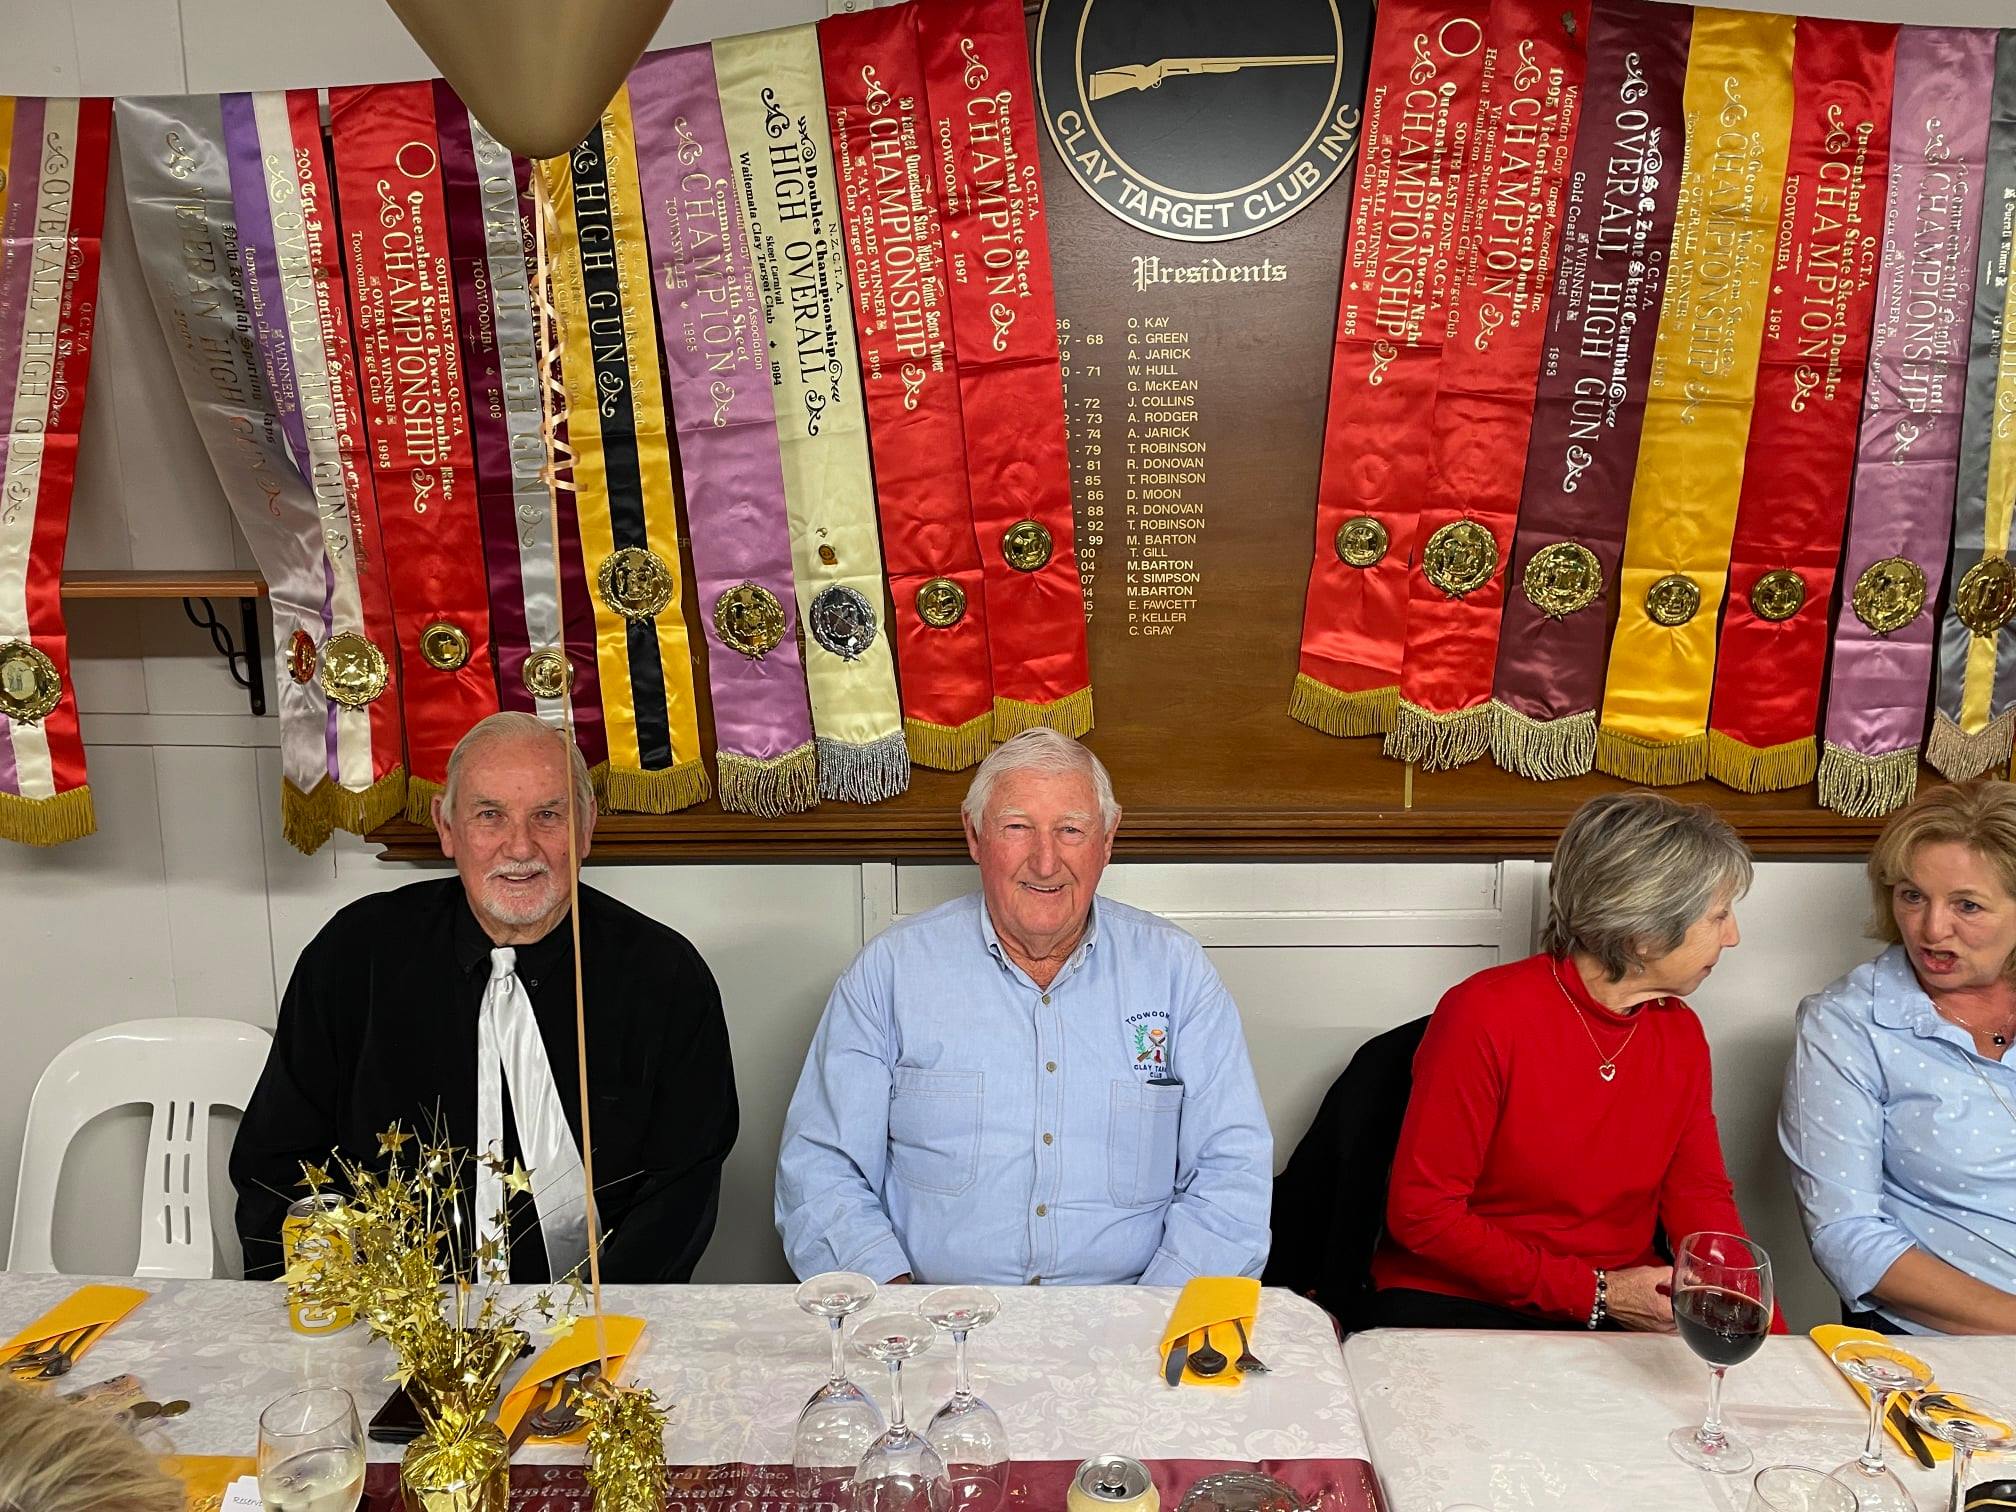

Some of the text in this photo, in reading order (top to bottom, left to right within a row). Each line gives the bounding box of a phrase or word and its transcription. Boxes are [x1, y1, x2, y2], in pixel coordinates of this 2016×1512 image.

[295, 148, 311, 180] 200
[739, 152, 757, 218] Waitemata
[938, 118, 968, 284] TOOWOOMBA 1997
[966, 98, 1017, 296] CHAMPION
[995, 90, 1032, 298] Queensland State Skeet
[1057, 104, 1360, 229] CLAY TARGET CLUB INC
[1415, 83, 1457, 298] Queensland State Tower
[1447, 100, 1491, 308] Frankston Australian Target
[1466, 104, 1503, 287] Victorian Skeet Carnival
[1482, 97, 1541, 298] CHAMPION
[1510, 66, 1564, 327] 1995 Victorian Skeet Doubles
[1535, 85, 1578, 290] Victorian Clay Target Association
[575, 183, 613, 272] HIGH
[835, 107, 883, 379] Toowoomba Clay Target Club 1996
[867, 117, 925, 358] CHAMPIONSHIP
[1344, 86, 1387, 335] Toowoomba Clay Target Club 1995
[1364, 148, 1392, 278] OVERALL WINNER
[1375, 89, 1438, 336] CHAMPIONSHIP
[1632, 220, 1652, 257] Zone
[1687, 132, 1749, 376] CHAMPIONSHIP
[1776, 175, 1800, 271] TOOWOOMBA
[434, 258, 448, 304] SOUTH
[681, 174, 735, 371] CHAMPION
[714, 178, 749, 361] Commonwealth Skeet
[757, 253, 771, 291] Target
[769, 146, 826, 383] HIGH OVERALL
[770, 265, 784, 305] Carnival
[806, 166, 838, 357] Doubles Championship
[861, 206, 888, 317] GRADE WINNER
[906, 155, 945, 372] Queensland State Night Points Score Tower
[1132, 256, 1287, 292] Presidents
[1568, 110, 1651, 440] OVERALL HIGH GUN
[1569, 246, 1589, 307] WINNER
[1622, 261, 1645, 307] Skeet
[1797, 162, 1850, 359] CHAMPION
[1824, 121, 1875, 401] Queensland State Skeet Doubles
[10, 180, 71, 476] OVERALL HIGH GUN
[350, 230, 391, 468] Toowoomba Clay Target Club 1995
[372, 288, 396, 412] OVERALL WINNER
[383, 232, 435, 466] CHAMPIONSHIP
[408, 191, 456, 501] Queensland State Tower Double Rise
[471, 259, 492, 353] TOOWOOMBA
[586, 291, 624, 362] GUN
[746, 306, 765, 370] Association
[1128, 318, 1169, 328] O. KAY
[1128, 333, 1188, 344] G. GREEN
[1611, 312, 1639, 382] Carnival
[274, 342, 295, 400] WINNER
[276, 213, 349, 520] OVERALL HIGH GUN
[1128, 349, 1191, 360] A. JARICK
[1128, 365, 1178, 375] W. HULL
[1128, 381, 1198, 392] G. McKEAN
[1128, 396, 1194, 407] J. COLLINS
[1128, 412, 1198, 422] A. RODGER
[1128, 427, 1189, 438] A. JARICK
[1127, 458, 1204, 469] R. DONOVAN
[1128, 443, 1206, 453] T. ROBINSON
[1128, 474, 1205, 485] T. ROBINSON
[1127, 489, 1181, 500] D. MOON
[1127, 504, 1203, 515] R. DONOVAN
[1127, 519, 1205, 530] T. ROBINSON
[1127, 535, 1196, 545] M. BARTON
[1127, 573, 1200, 583] K. SIMPSON
[1130, 548, 1168, 557] T. GILL
[1129, 600, 1197, 610] E. FAWCETT
[1129, 613, 1186, 622] P. KELLER
[1129, 626, 1174, 636] C. GRAY
